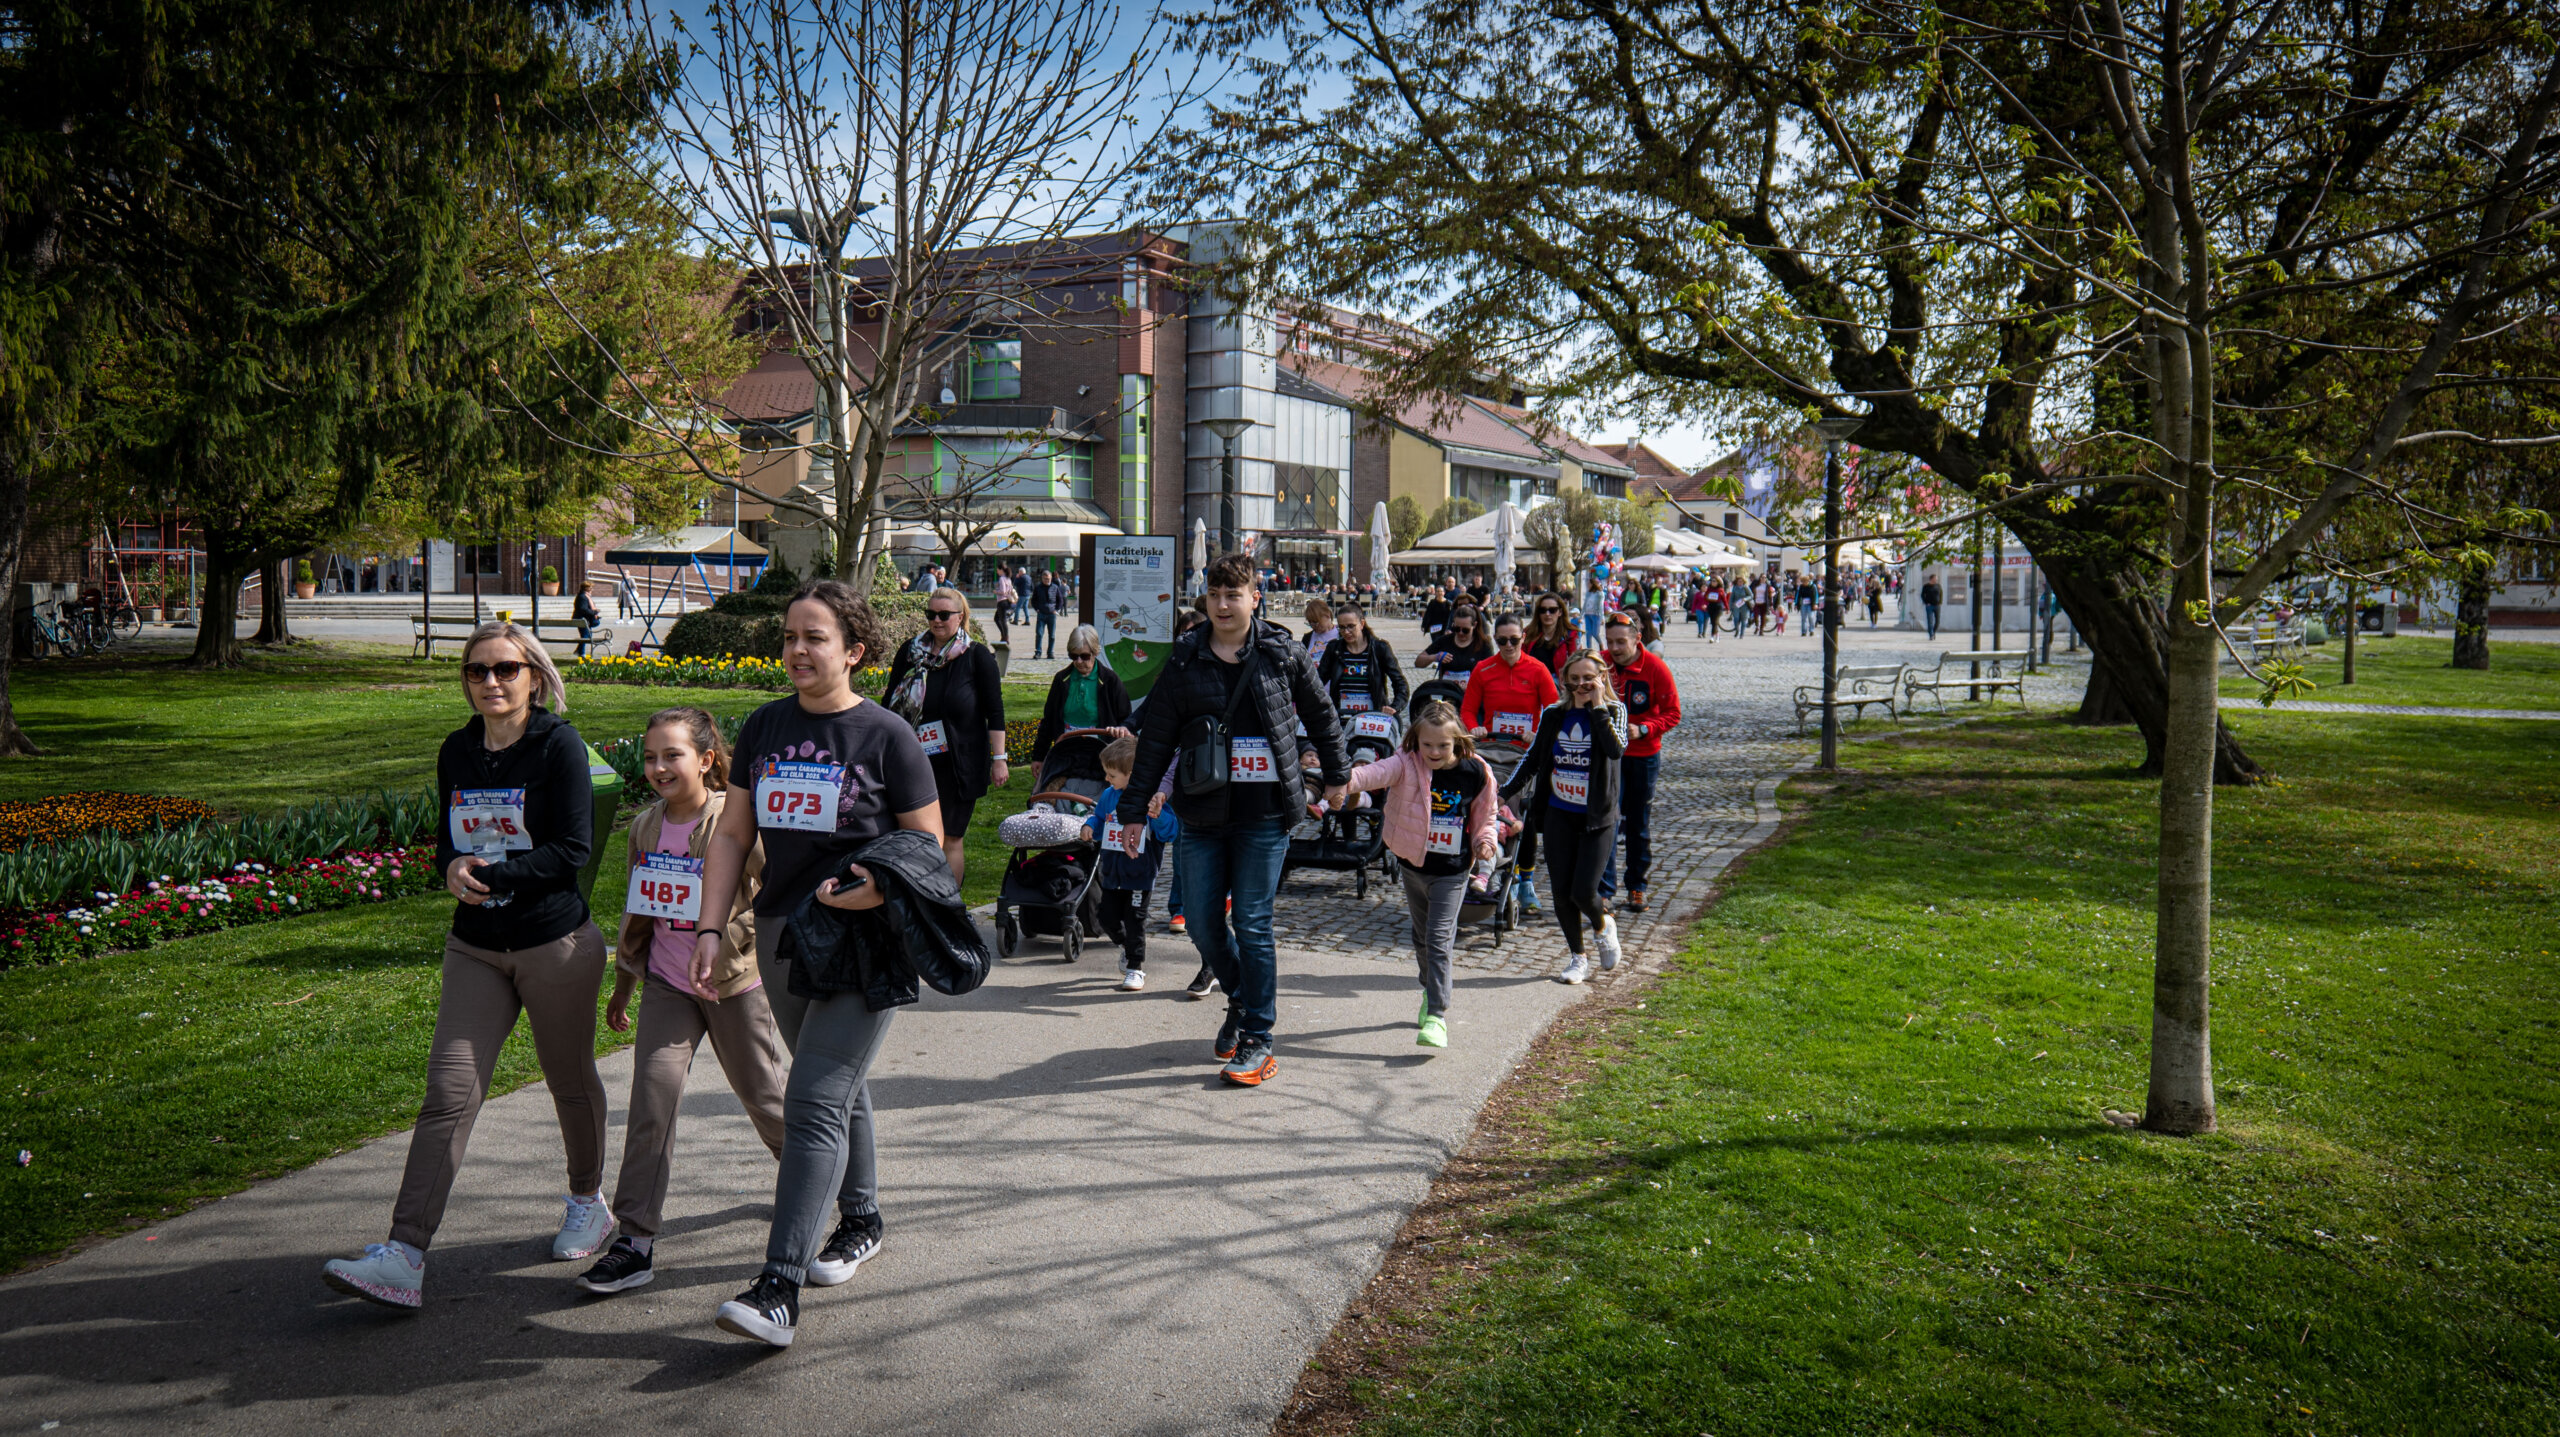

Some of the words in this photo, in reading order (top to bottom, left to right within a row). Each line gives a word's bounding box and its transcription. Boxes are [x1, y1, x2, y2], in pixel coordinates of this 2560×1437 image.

[1104, 546, 1164, 558] Graditeljska
[1104, 556, 1140, 565] baština
[2008, 556, 2032, 565] KNJI
[1361, 722, 1384, 732] 198
[1500, 724, 1524, 735] 235
[1232, 756, 1268, 771] 243
[1554, 754, 1590, 766] adida
[799, 764, 829, 774] ČARAPAMA
[1556, 781, 1585, 797] 444
[768, 791, 822, 815] 073
[1108, 830, 1123, 842] 59
[1428, 832, 1452, 845] 44
[665, 856, 691, 866] ČARAPAMA
[640, 880, 690, 905] 487
